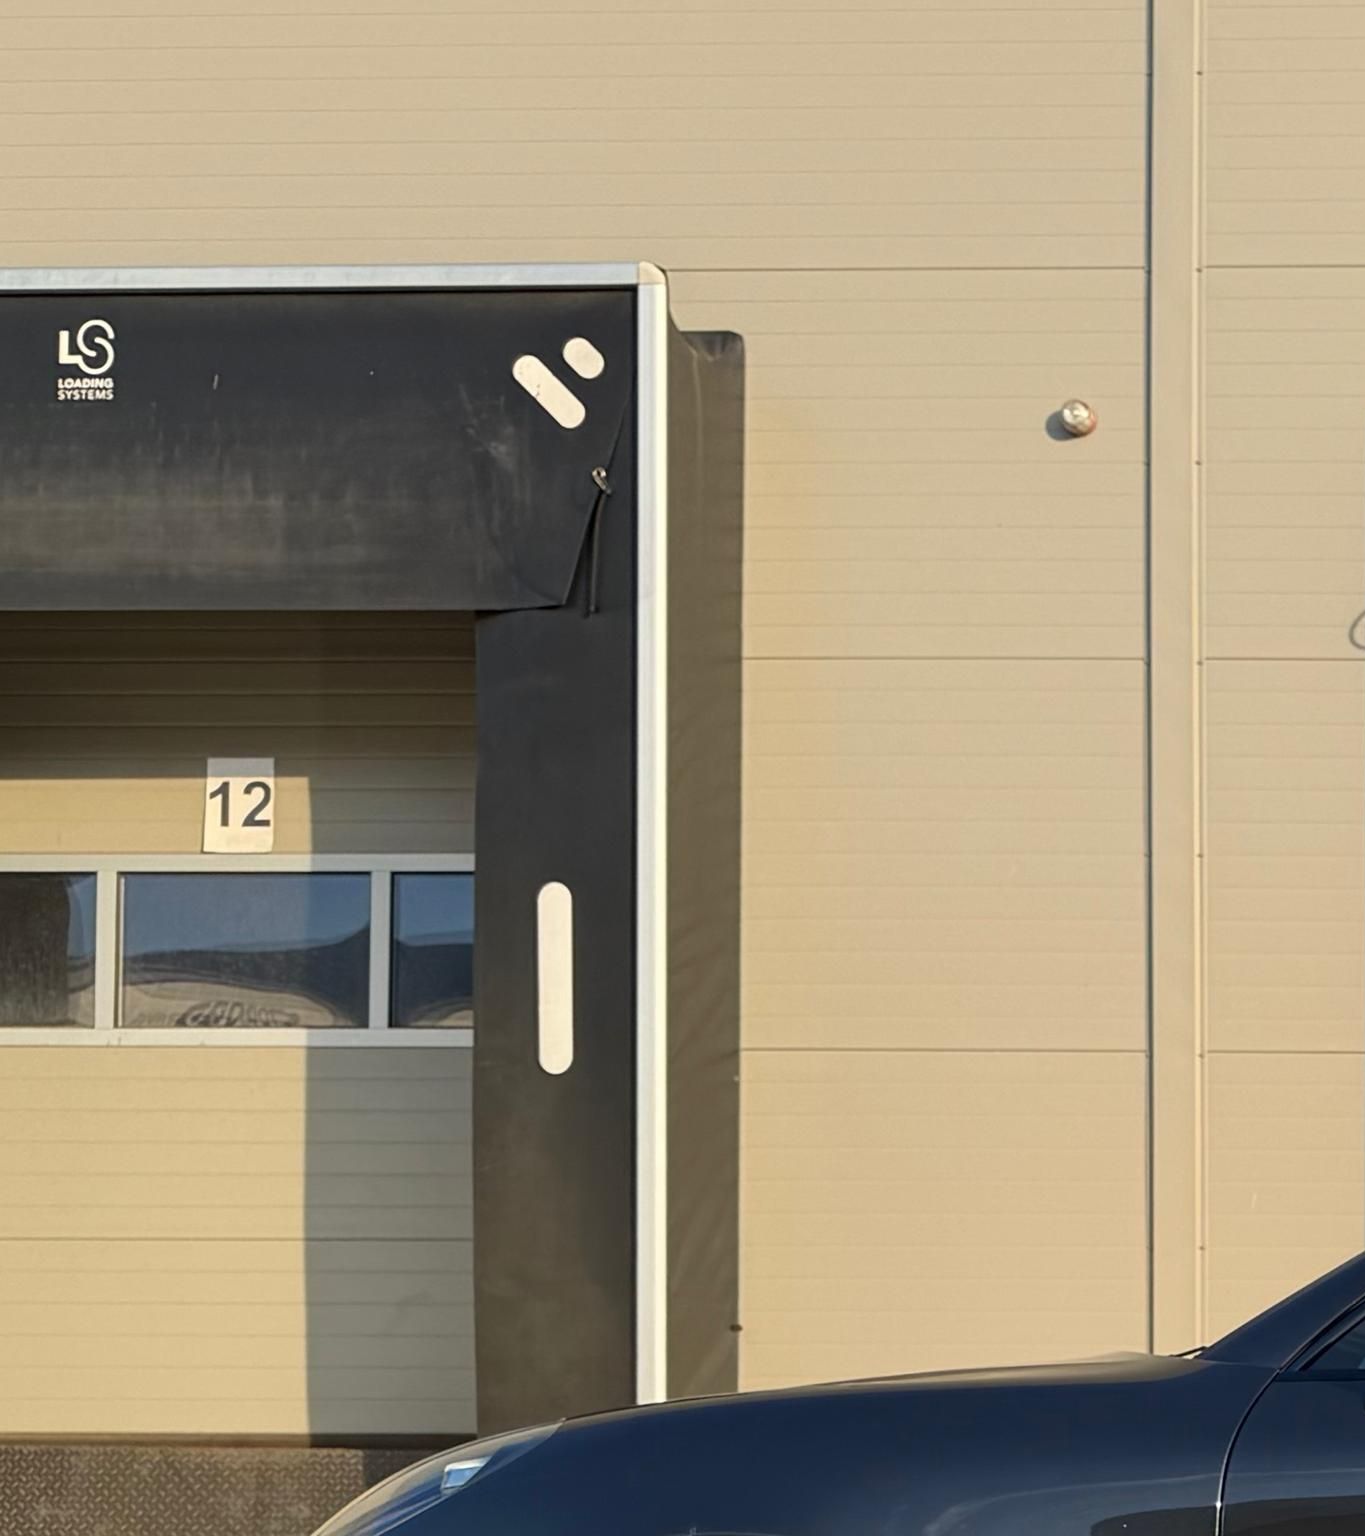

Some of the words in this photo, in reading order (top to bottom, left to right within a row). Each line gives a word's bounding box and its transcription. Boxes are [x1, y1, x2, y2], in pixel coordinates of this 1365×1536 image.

[58, 319, 115, 375] LS
[57, 377, 114, 389] LOADING
[57, 388, 114, 400] SYSTEMS
[209, 781, 271, 827] 12
